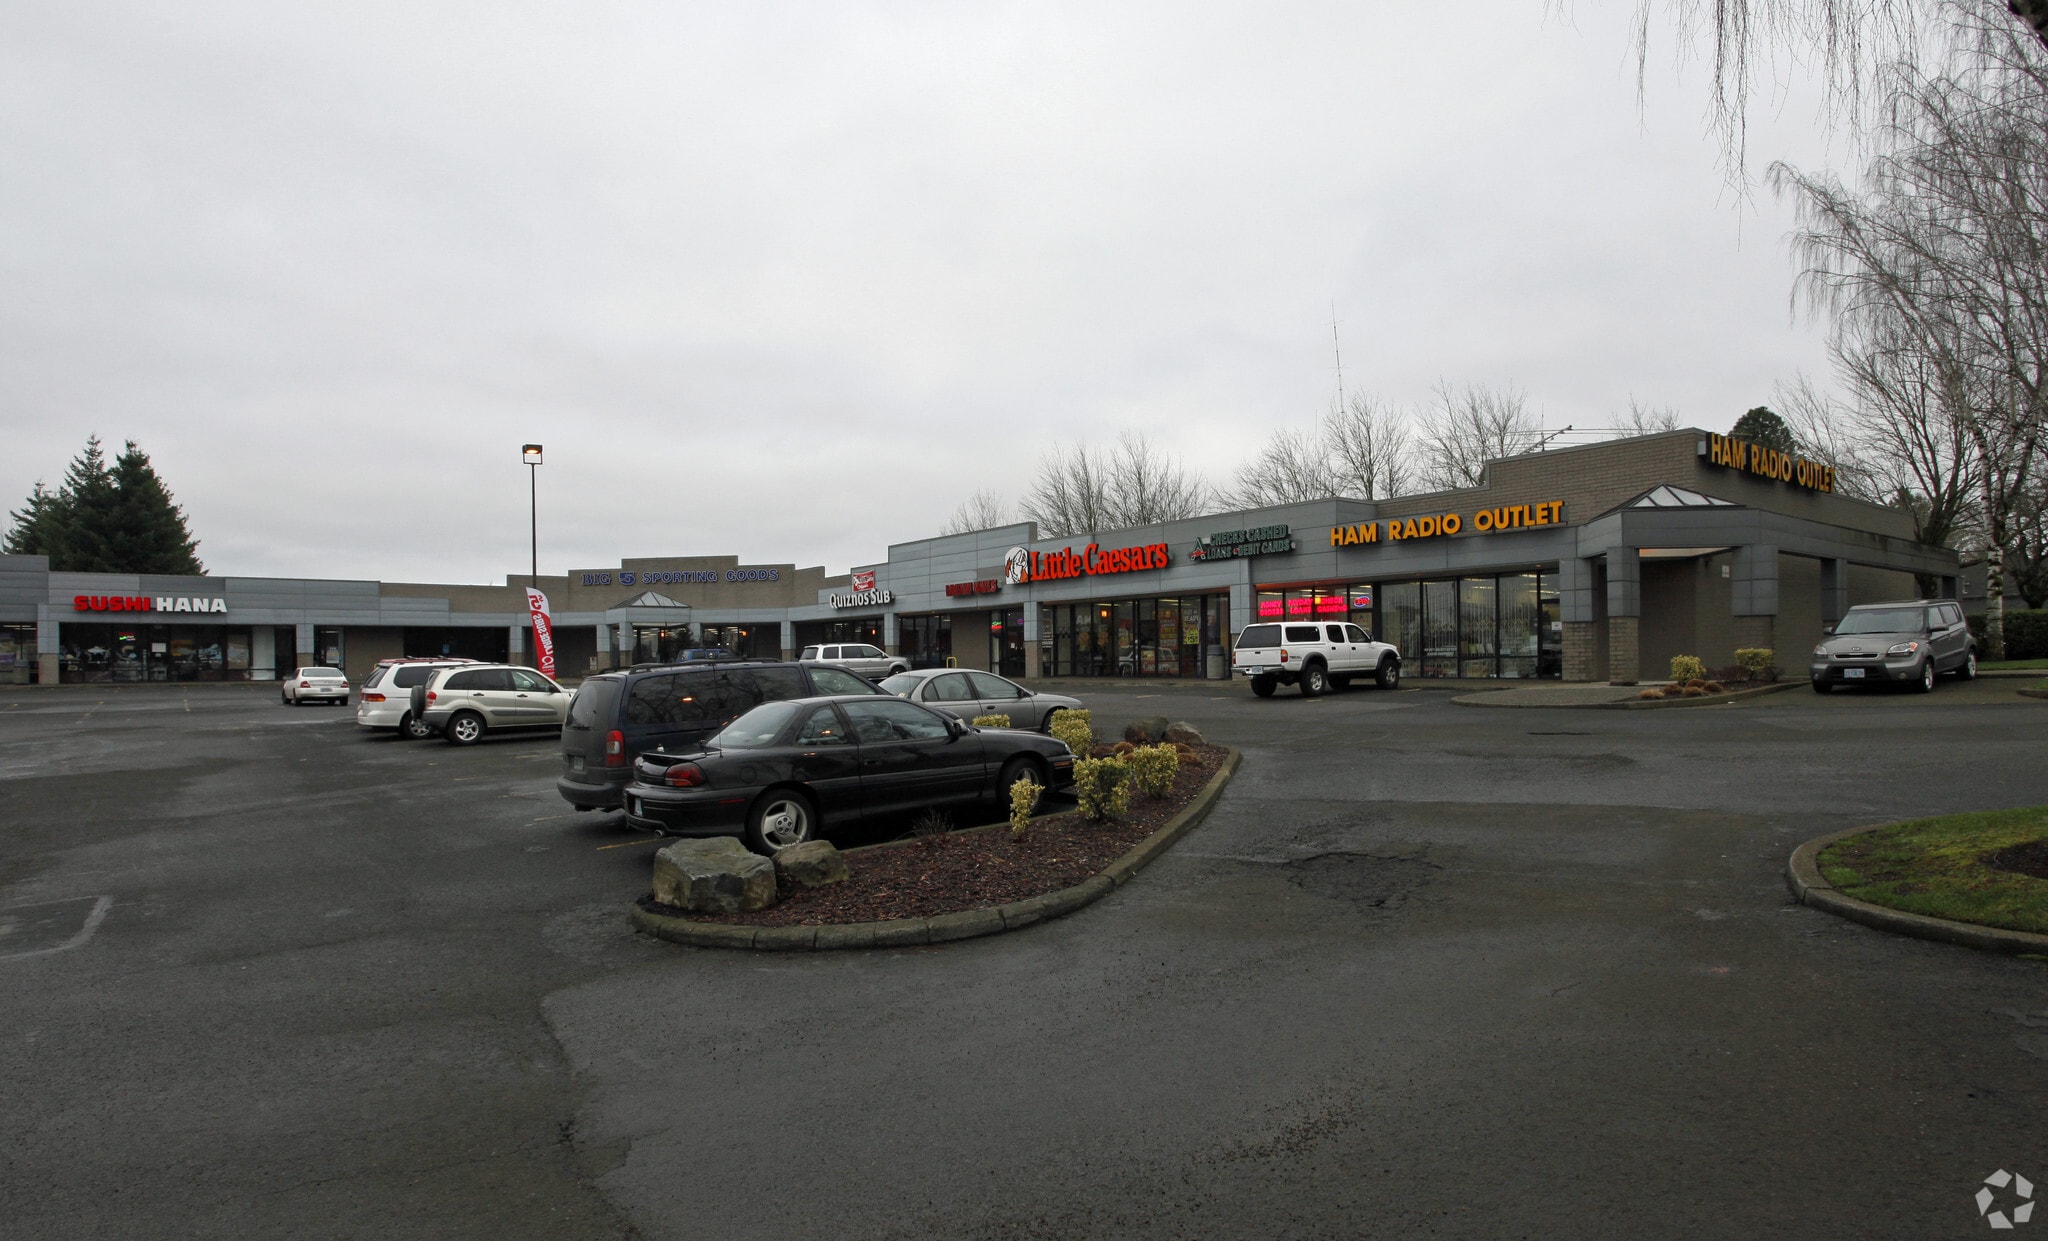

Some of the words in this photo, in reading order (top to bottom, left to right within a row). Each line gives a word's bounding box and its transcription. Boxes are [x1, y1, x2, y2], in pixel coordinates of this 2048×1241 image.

[1711, 432, 1745, 470] HAM
[1751, 443, 1793, 482] RADIO
[1797, 457, 1836, 493] OUTLET
[1330, 523, 1378, 547] HAM
[1388, 513, 1461, 540] RADIO
[1474, 501, 1564, 531] OUTLET
[1210, 529, 1246, 546] CHECKS
[1247, 525, 1287, 542] CASHED
[1207, 546, 1232, 560] LOANS
[1261, 539, 1290, 554] CARDS
[1030, 547, 1082, 581] Little
[1083, 543, 1169, 576] Caesars
[582, 572, 611, 586] BIG
[618, 572, 636, 586] 5
[642, 570, 718, 585] SPORTING
[725, 569, 779, 582] GOODS
[73, 595, 151, 612] SUSHI
[156, 597, 227, 613] HANA
